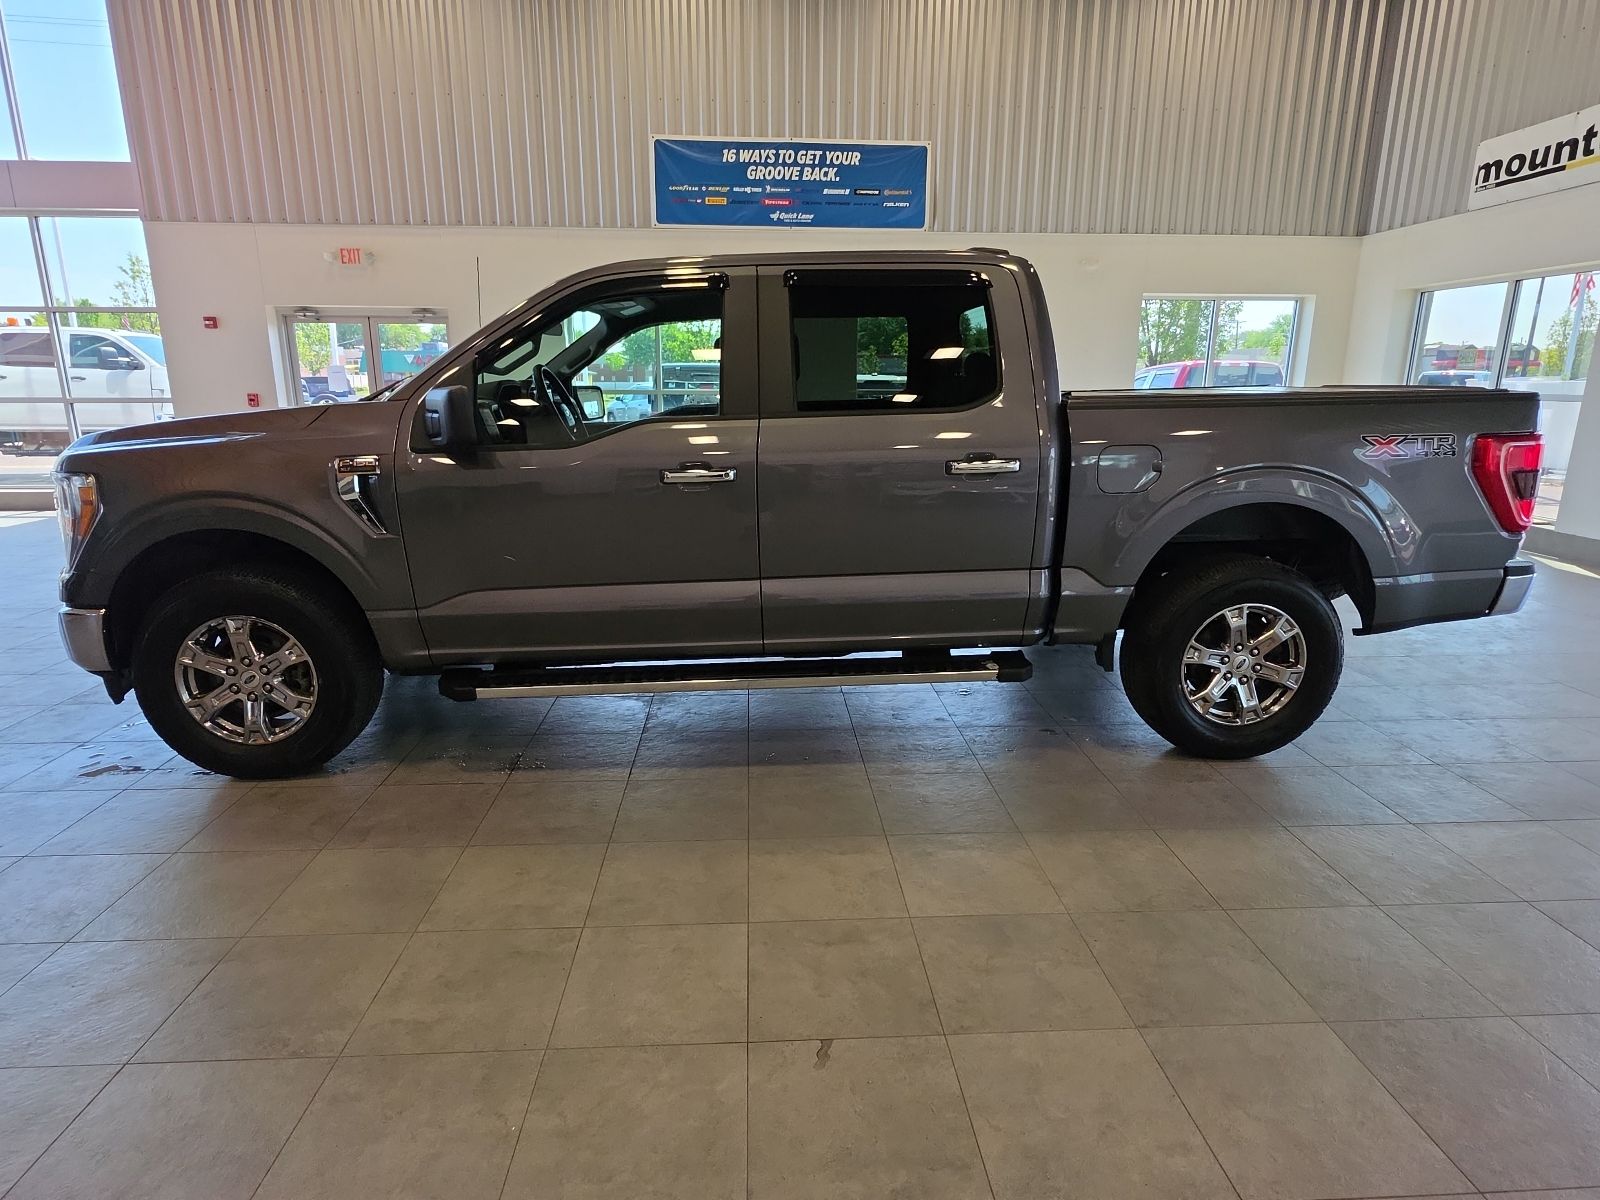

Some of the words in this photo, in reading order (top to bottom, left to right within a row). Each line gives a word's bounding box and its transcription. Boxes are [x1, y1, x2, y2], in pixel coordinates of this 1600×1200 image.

[722, 148, 737, 163] 16
[739, 149, 776, 164] WAYS
[778, 149, 795, 164] TO
[796, 150, 823, 165] GET
[825, 150, 861, 166] YOUR
[1475, 123, 1600, 187] mount
[746, 165, 801, 180] GROOVE
[802, 166, 840, 181] BACK.
[779, 212, 798, 220] Quick
[339, 247, 361, 265] EXIT
